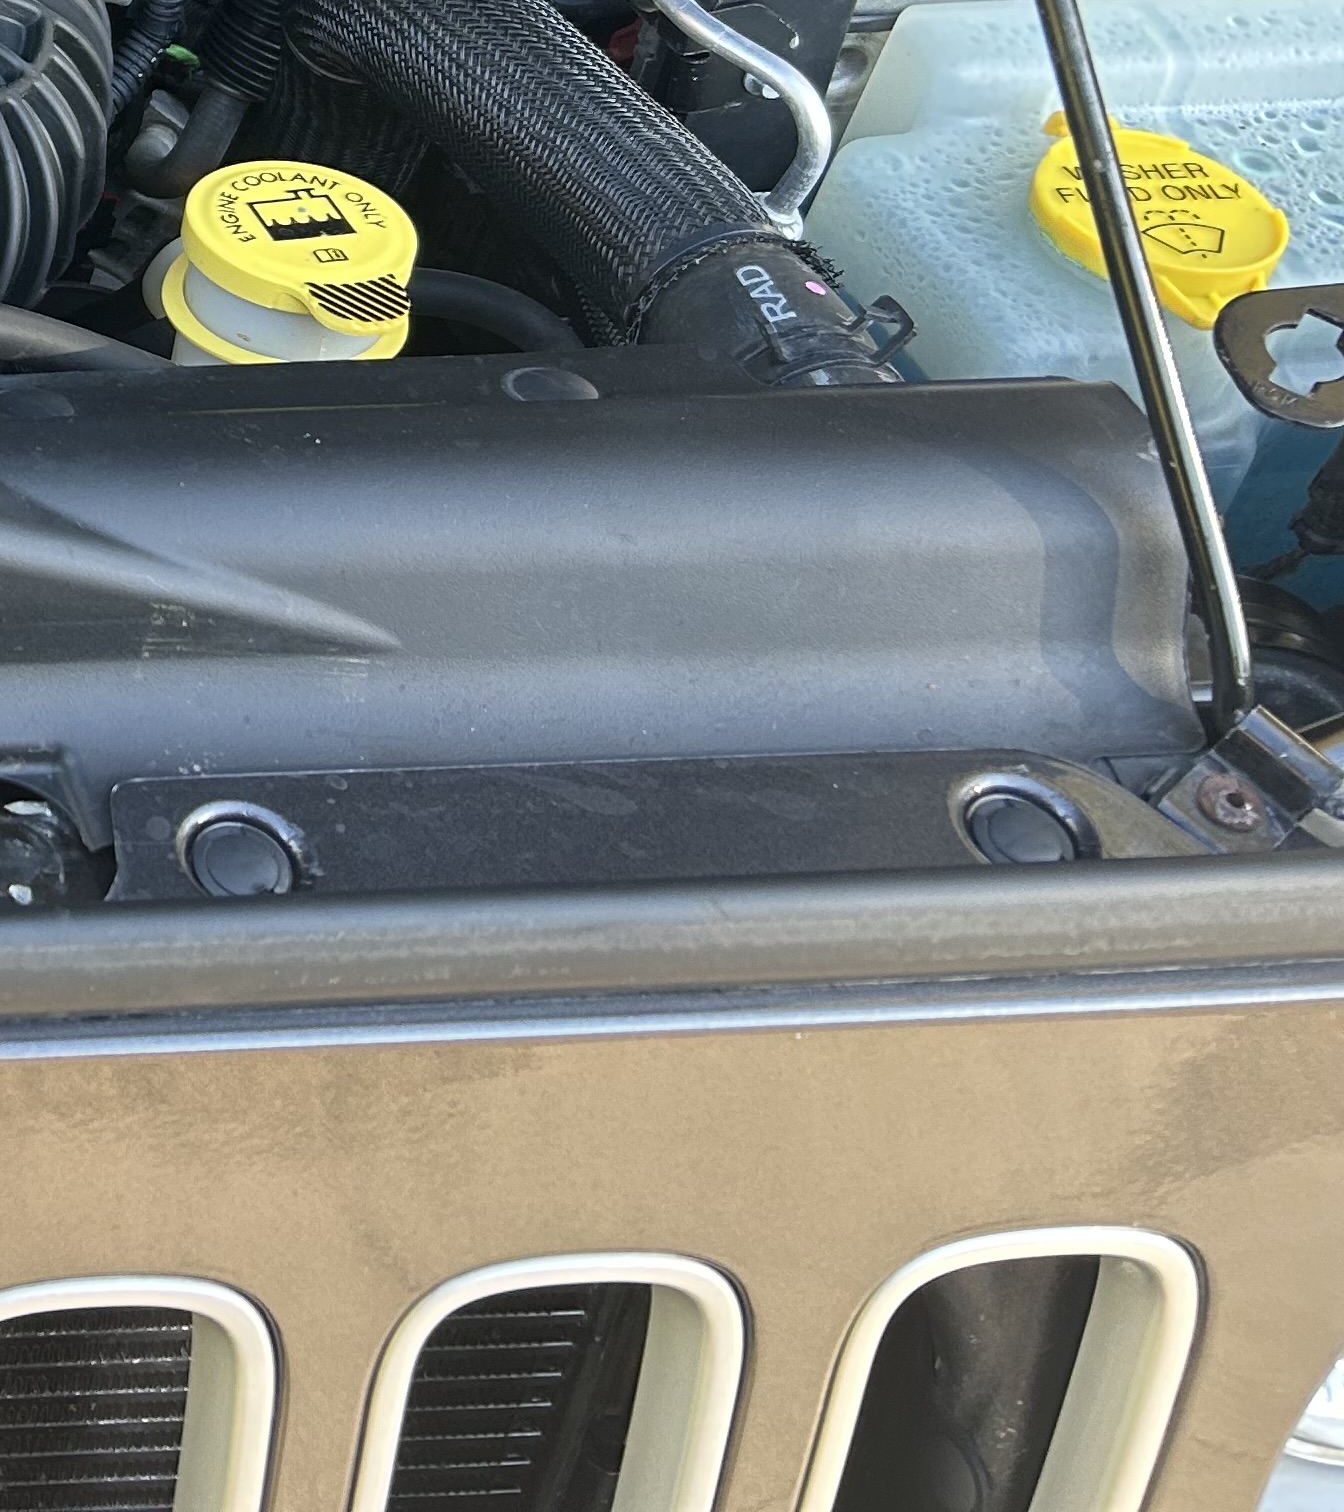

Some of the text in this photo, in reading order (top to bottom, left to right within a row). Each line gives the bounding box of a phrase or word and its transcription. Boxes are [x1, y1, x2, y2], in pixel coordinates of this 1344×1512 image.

[1061, 162, 1210, 181] WSHER
[216, 171, 388, 243] ENGINE COOLANT ONLY
[1055, 183, 1243, 204] FLD ONLY
[735, 264, 798, 323] RAD
